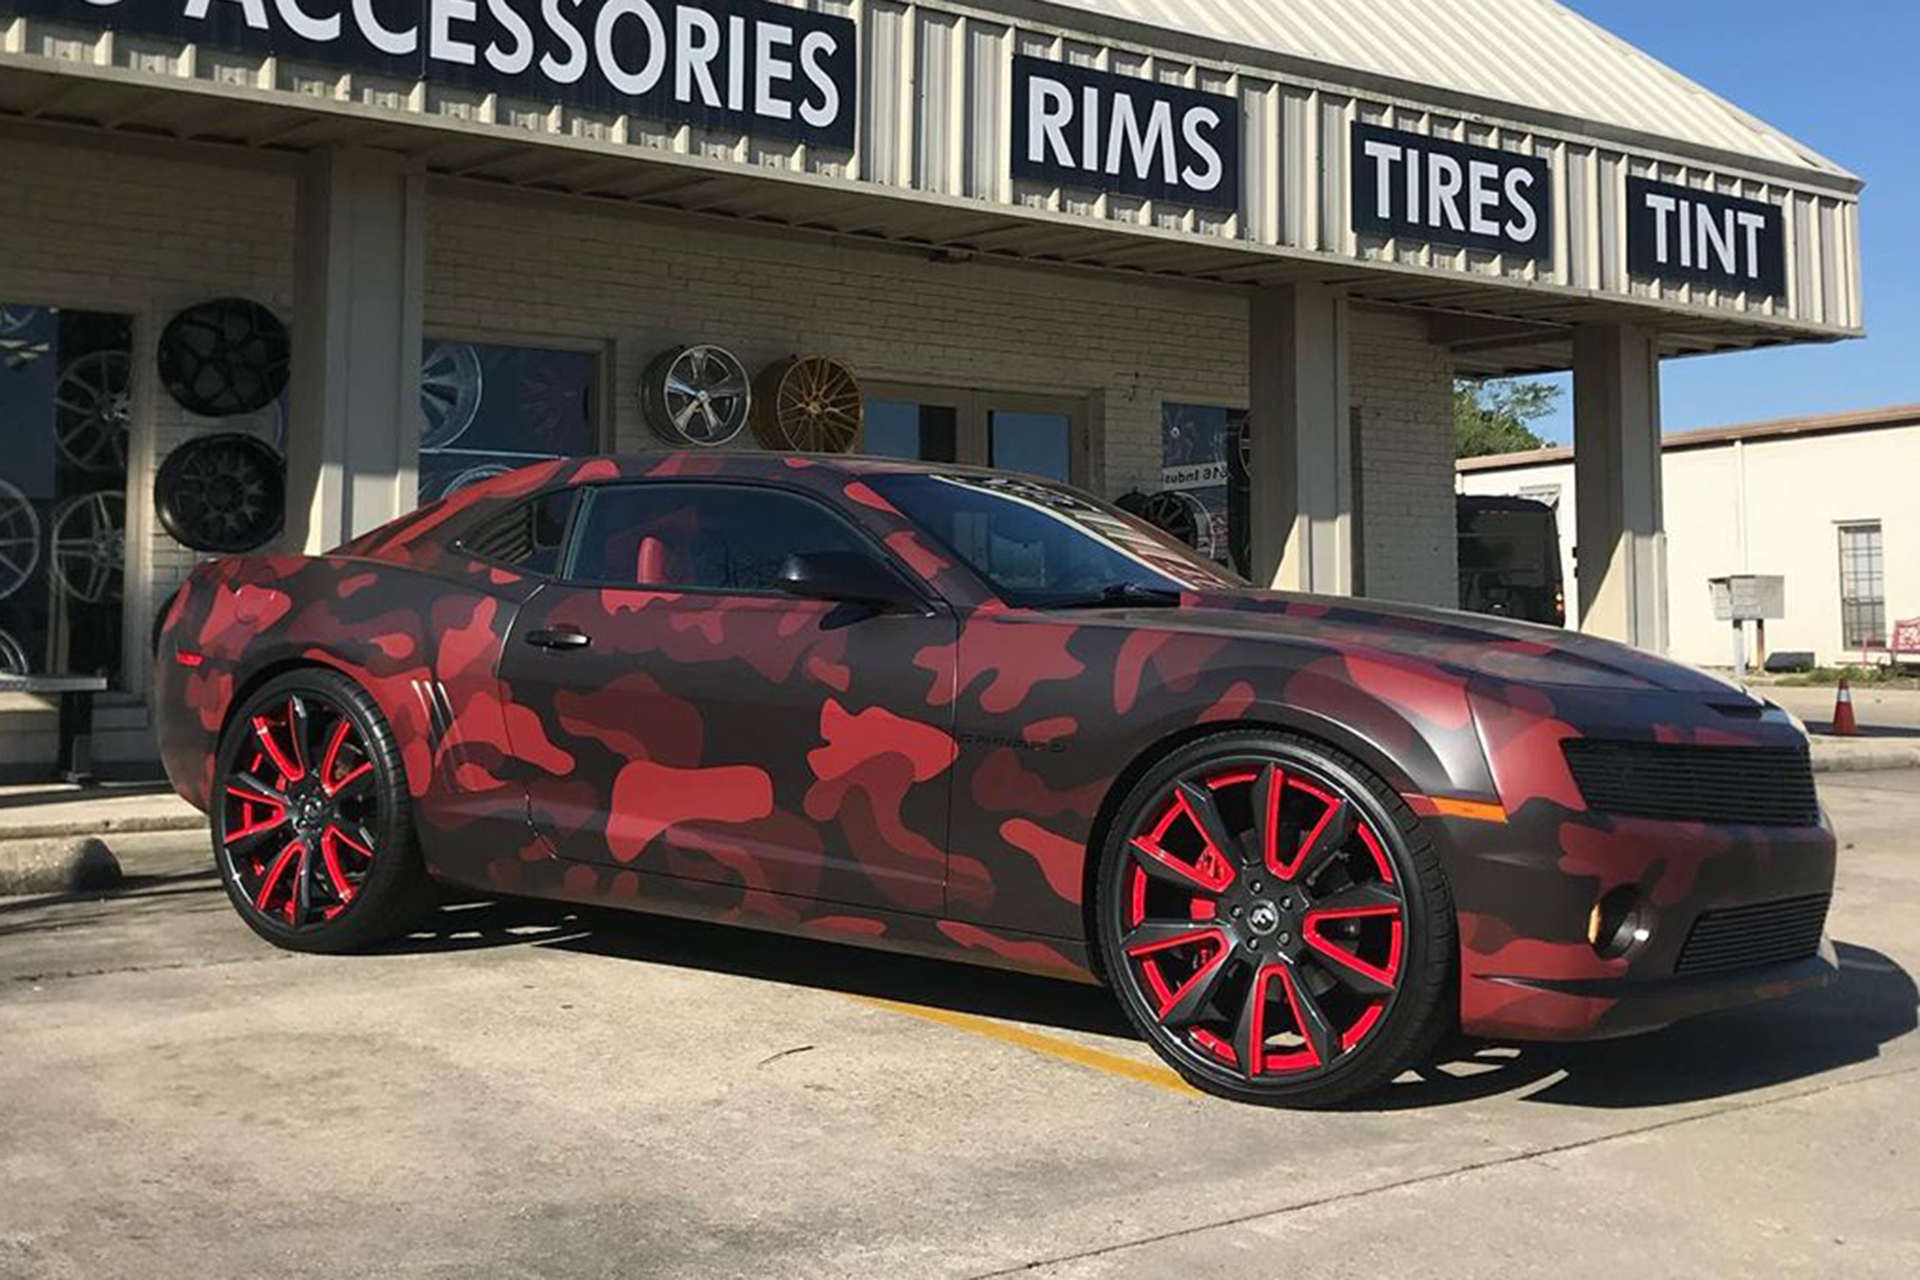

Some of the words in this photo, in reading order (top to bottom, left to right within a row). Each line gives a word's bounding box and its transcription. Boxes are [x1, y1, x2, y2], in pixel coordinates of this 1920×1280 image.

[184, 0, 840, 127] CESSORIES
[1028, 75, 1222, 191] RIMS
[1364, 140, 1537, 242] TIRES
[1645, 193, 1766, 279] TINT
